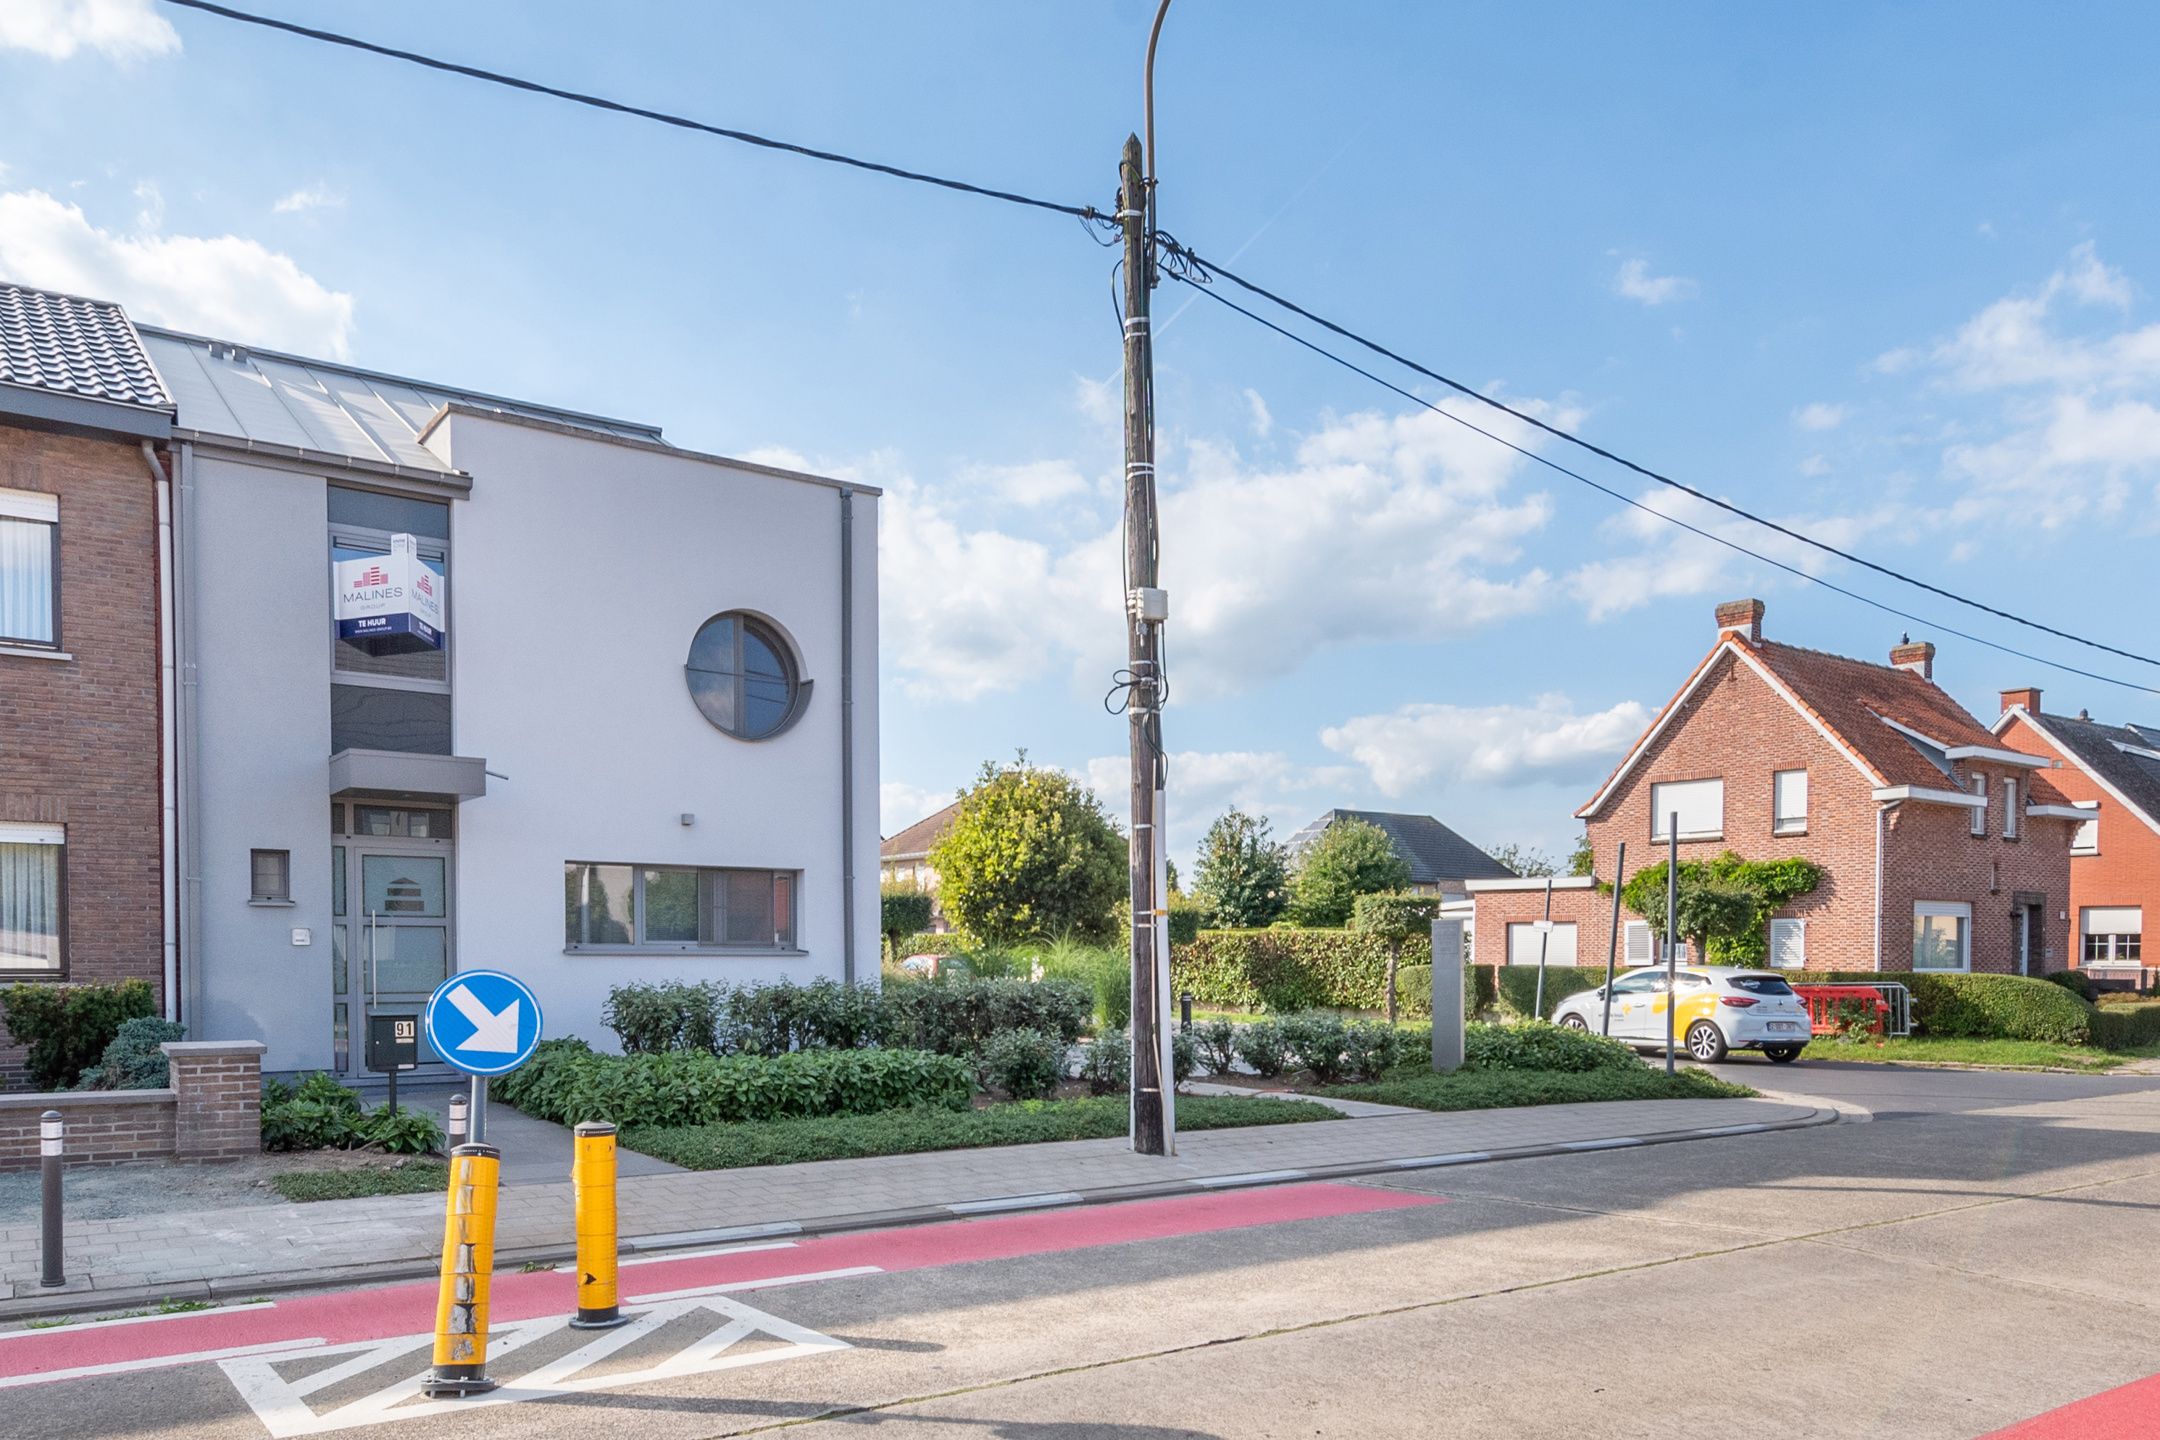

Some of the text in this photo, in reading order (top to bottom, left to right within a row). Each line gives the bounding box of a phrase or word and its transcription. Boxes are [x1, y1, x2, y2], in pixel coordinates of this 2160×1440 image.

[343, 587, 403, 604] MALINES
[411, 589, 439, 614] MALINES
[358, 618, 386, 628] TE HUUR
[396, 1023, 412, 1036] 91
